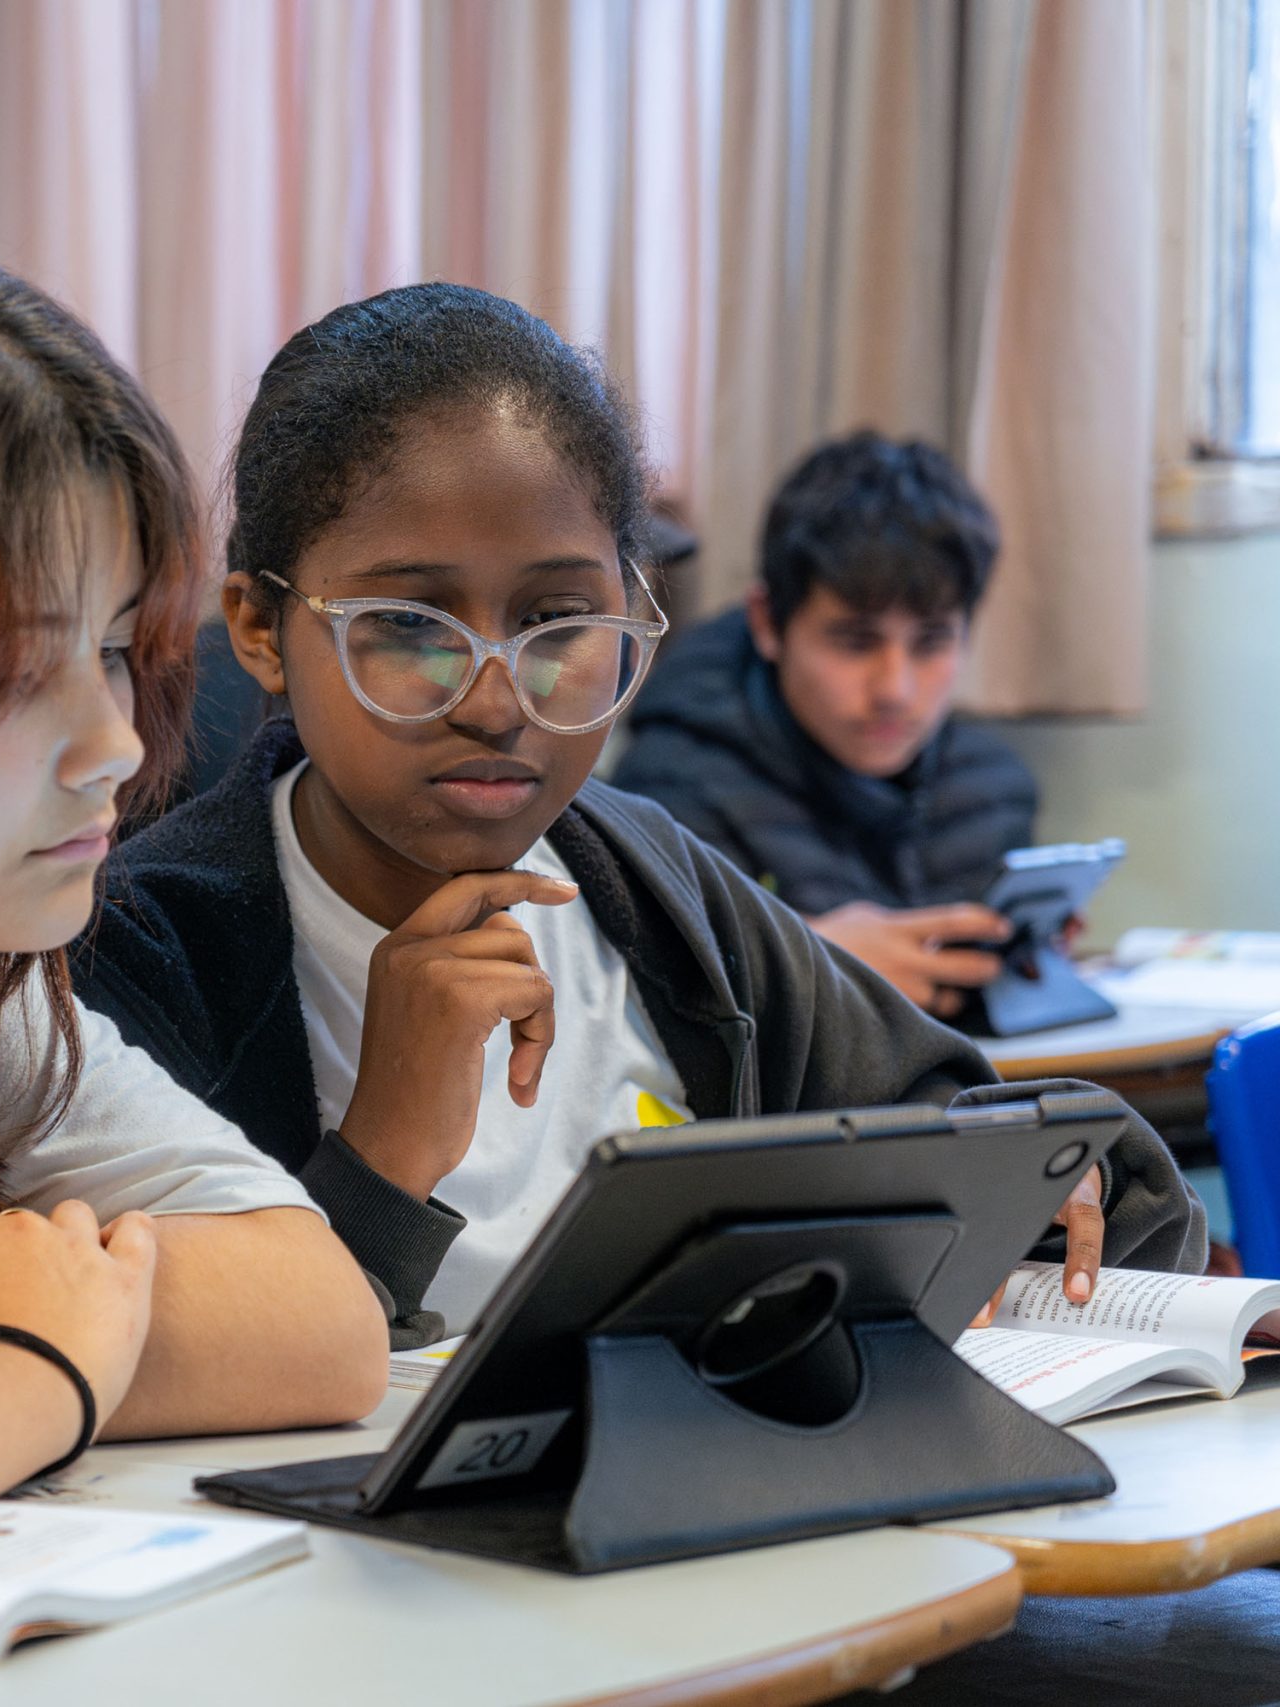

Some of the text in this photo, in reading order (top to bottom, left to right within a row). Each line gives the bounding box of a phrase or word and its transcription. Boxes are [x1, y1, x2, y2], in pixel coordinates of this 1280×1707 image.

[1012, 1282, 1031, 1317] sem que
[1027, 1291, 1039, 1309] com
[1037, 1284, 1058, 1320] Romênia
[1050, 1298, 1063, 1321] Leste
[1127, 1291, 1150, 1330] Roosevelt
[1157, 1300, 1171, 1319] final
[1139, 1315, 1149, 1332] dos
[1152, 1321, 1162, 1333] da
[455, 1427, 530, 1473] 20
